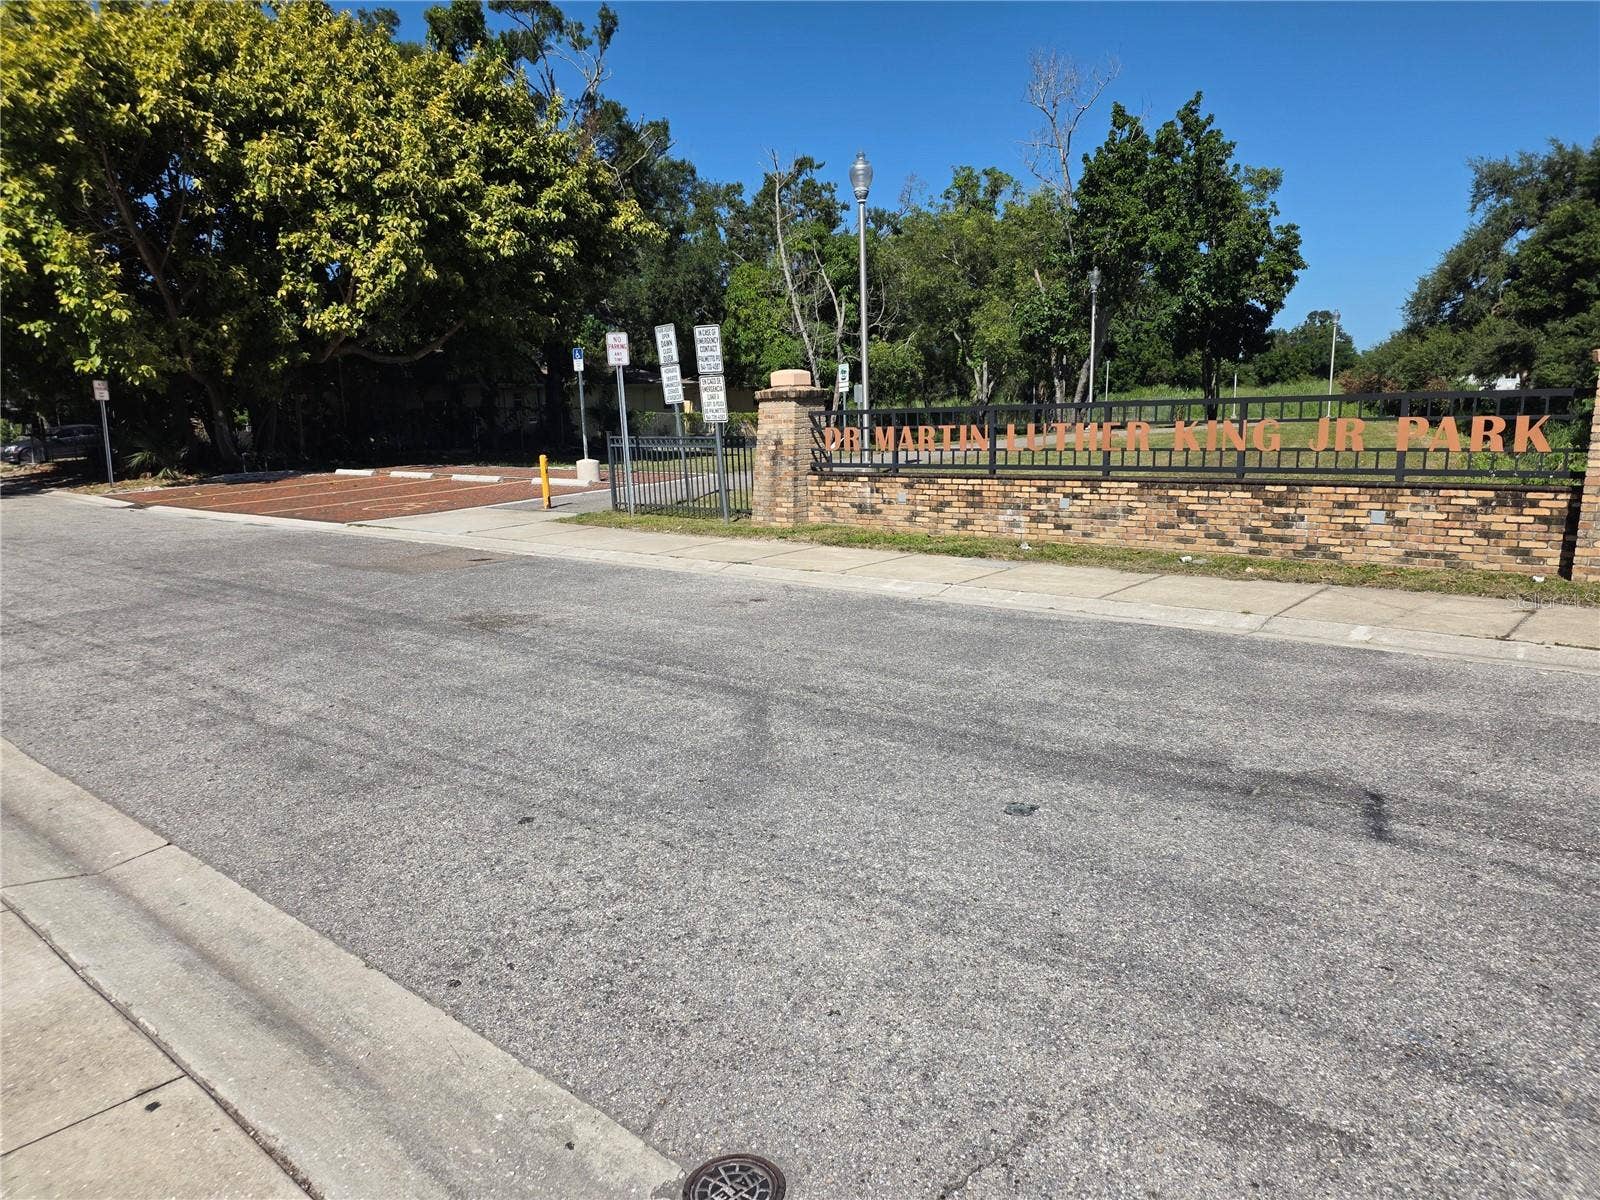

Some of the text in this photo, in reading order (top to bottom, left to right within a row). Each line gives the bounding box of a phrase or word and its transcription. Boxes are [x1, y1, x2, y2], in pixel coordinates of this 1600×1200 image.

[696, 336, 719, 345] EMERGENCY
[824, 415, 1552, 453] DR MARTIN LUTHER KING JR PARK
